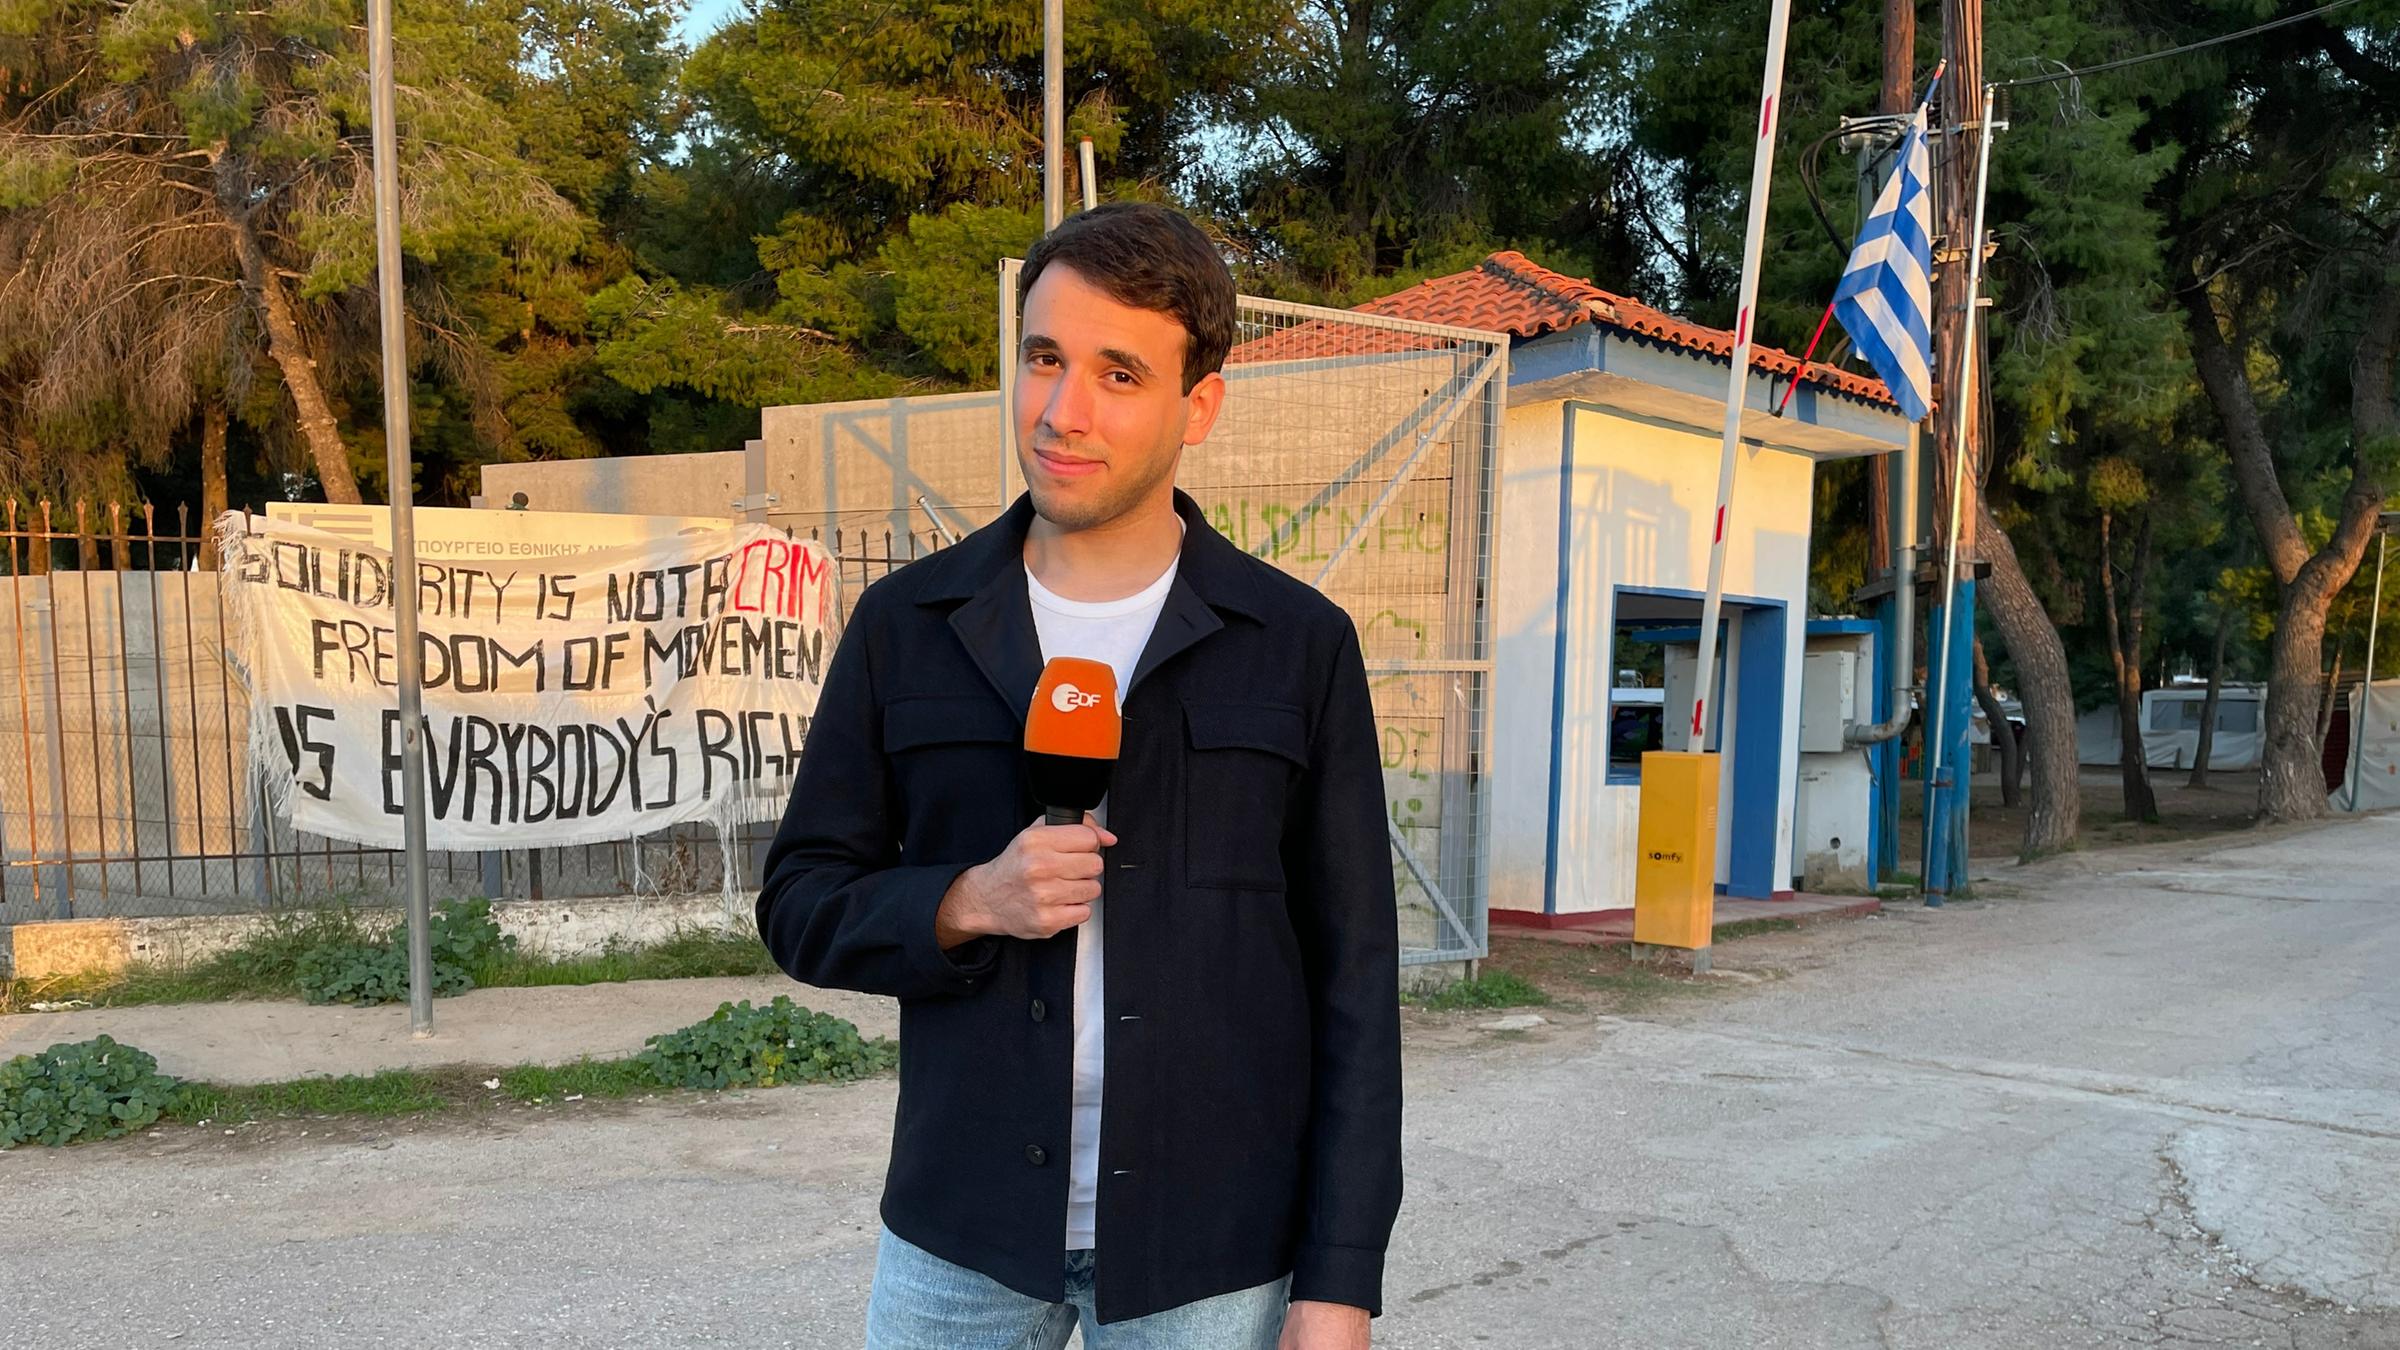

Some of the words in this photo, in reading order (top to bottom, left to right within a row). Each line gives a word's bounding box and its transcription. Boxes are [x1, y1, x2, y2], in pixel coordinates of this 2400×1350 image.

[239, 532, 518, 624] SOLIDRITY
[536, 573, 577, 621] IS
[413, 540, 504, 555] ΠΟΥΡΓΕΙΟ
[311, 619, 545, 692] FREDOM
[562, 631, 631, 691] OF
[274, 704, 335, 801] IS
[1648, 852, 1682, 864] somfy
